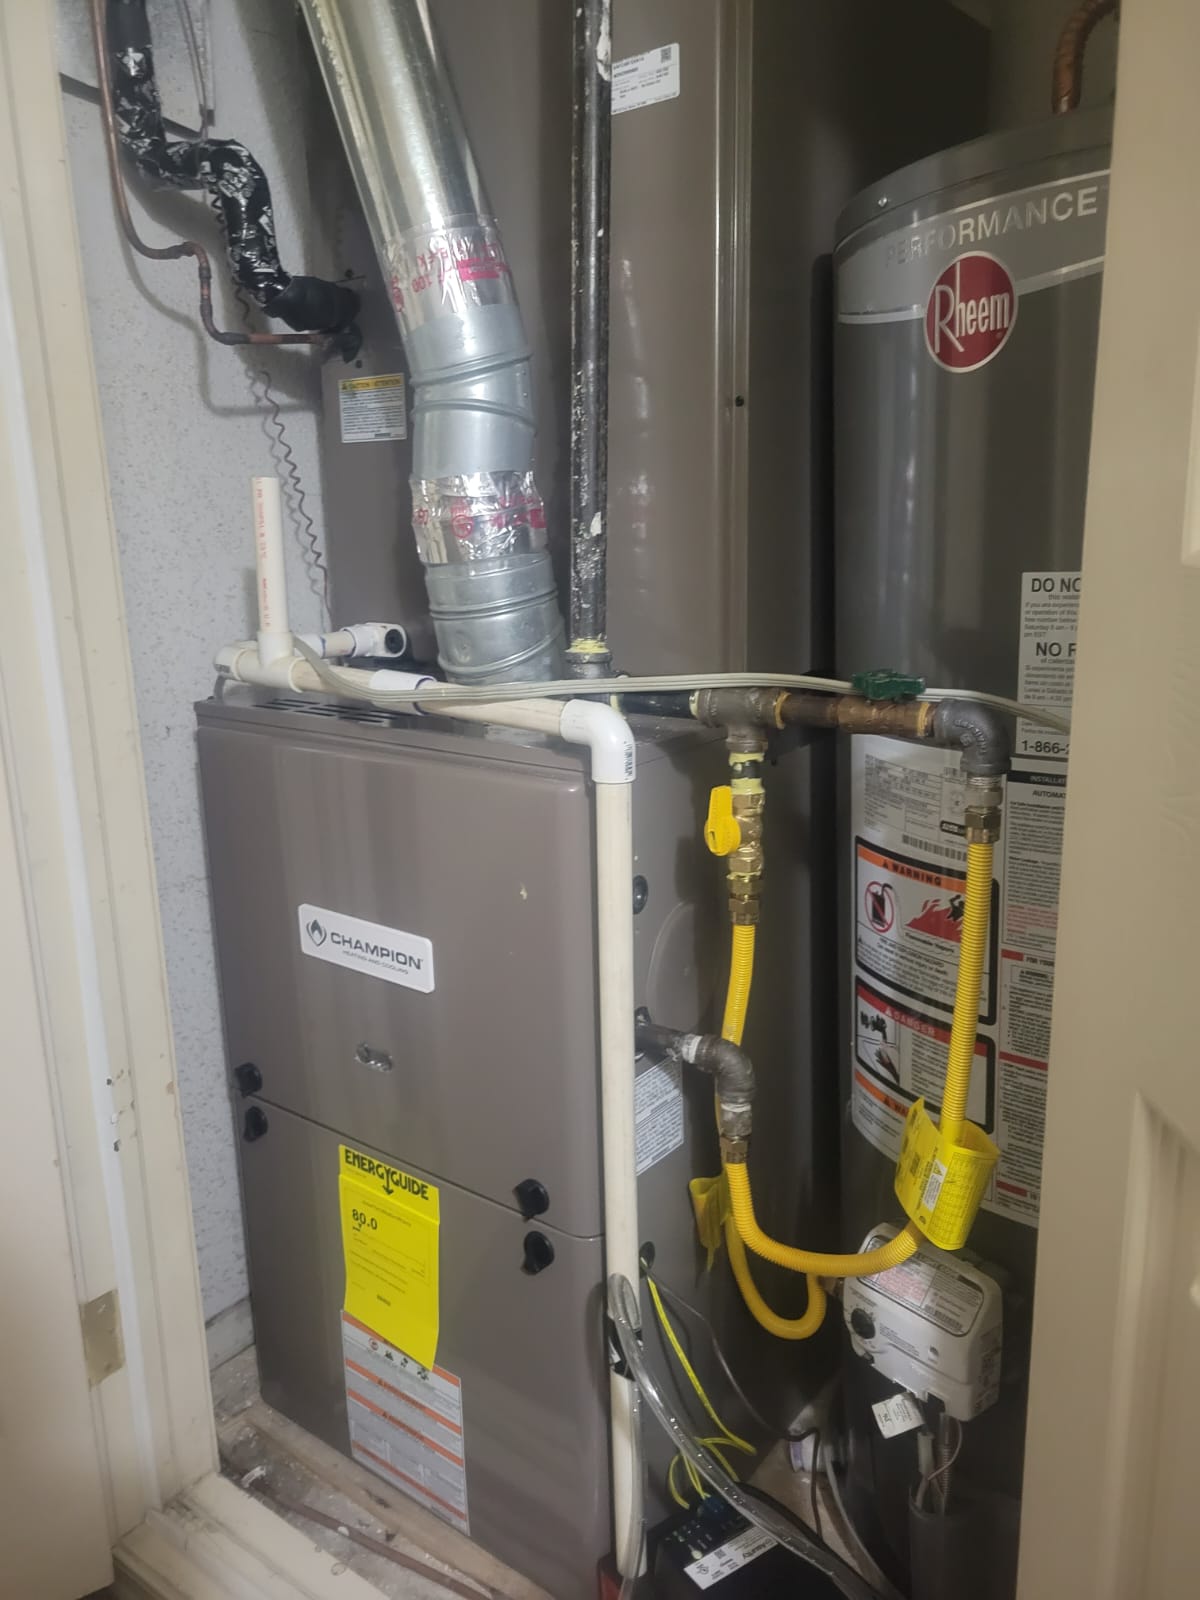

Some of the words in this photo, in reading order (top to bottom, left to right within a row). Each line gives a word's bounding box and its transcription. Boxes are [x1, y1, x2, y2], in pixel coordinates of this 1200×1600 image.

[886, 186, 1098, 267] PERFORMANCE
[934, 261, 1010, 353] Rheem
[1031, 577, 1055, 593] DO
[1035, 642, 1062, 657] NO
[892, 862, 942, 887] WARNING
[330, 932, 421, 970] CHAMPION
[893, 1012, 936, 1037] DANGER
[344, 1148, 429, 1201] ENERGYGUIDE
[351, 1208, 378, 1231] 80.0
